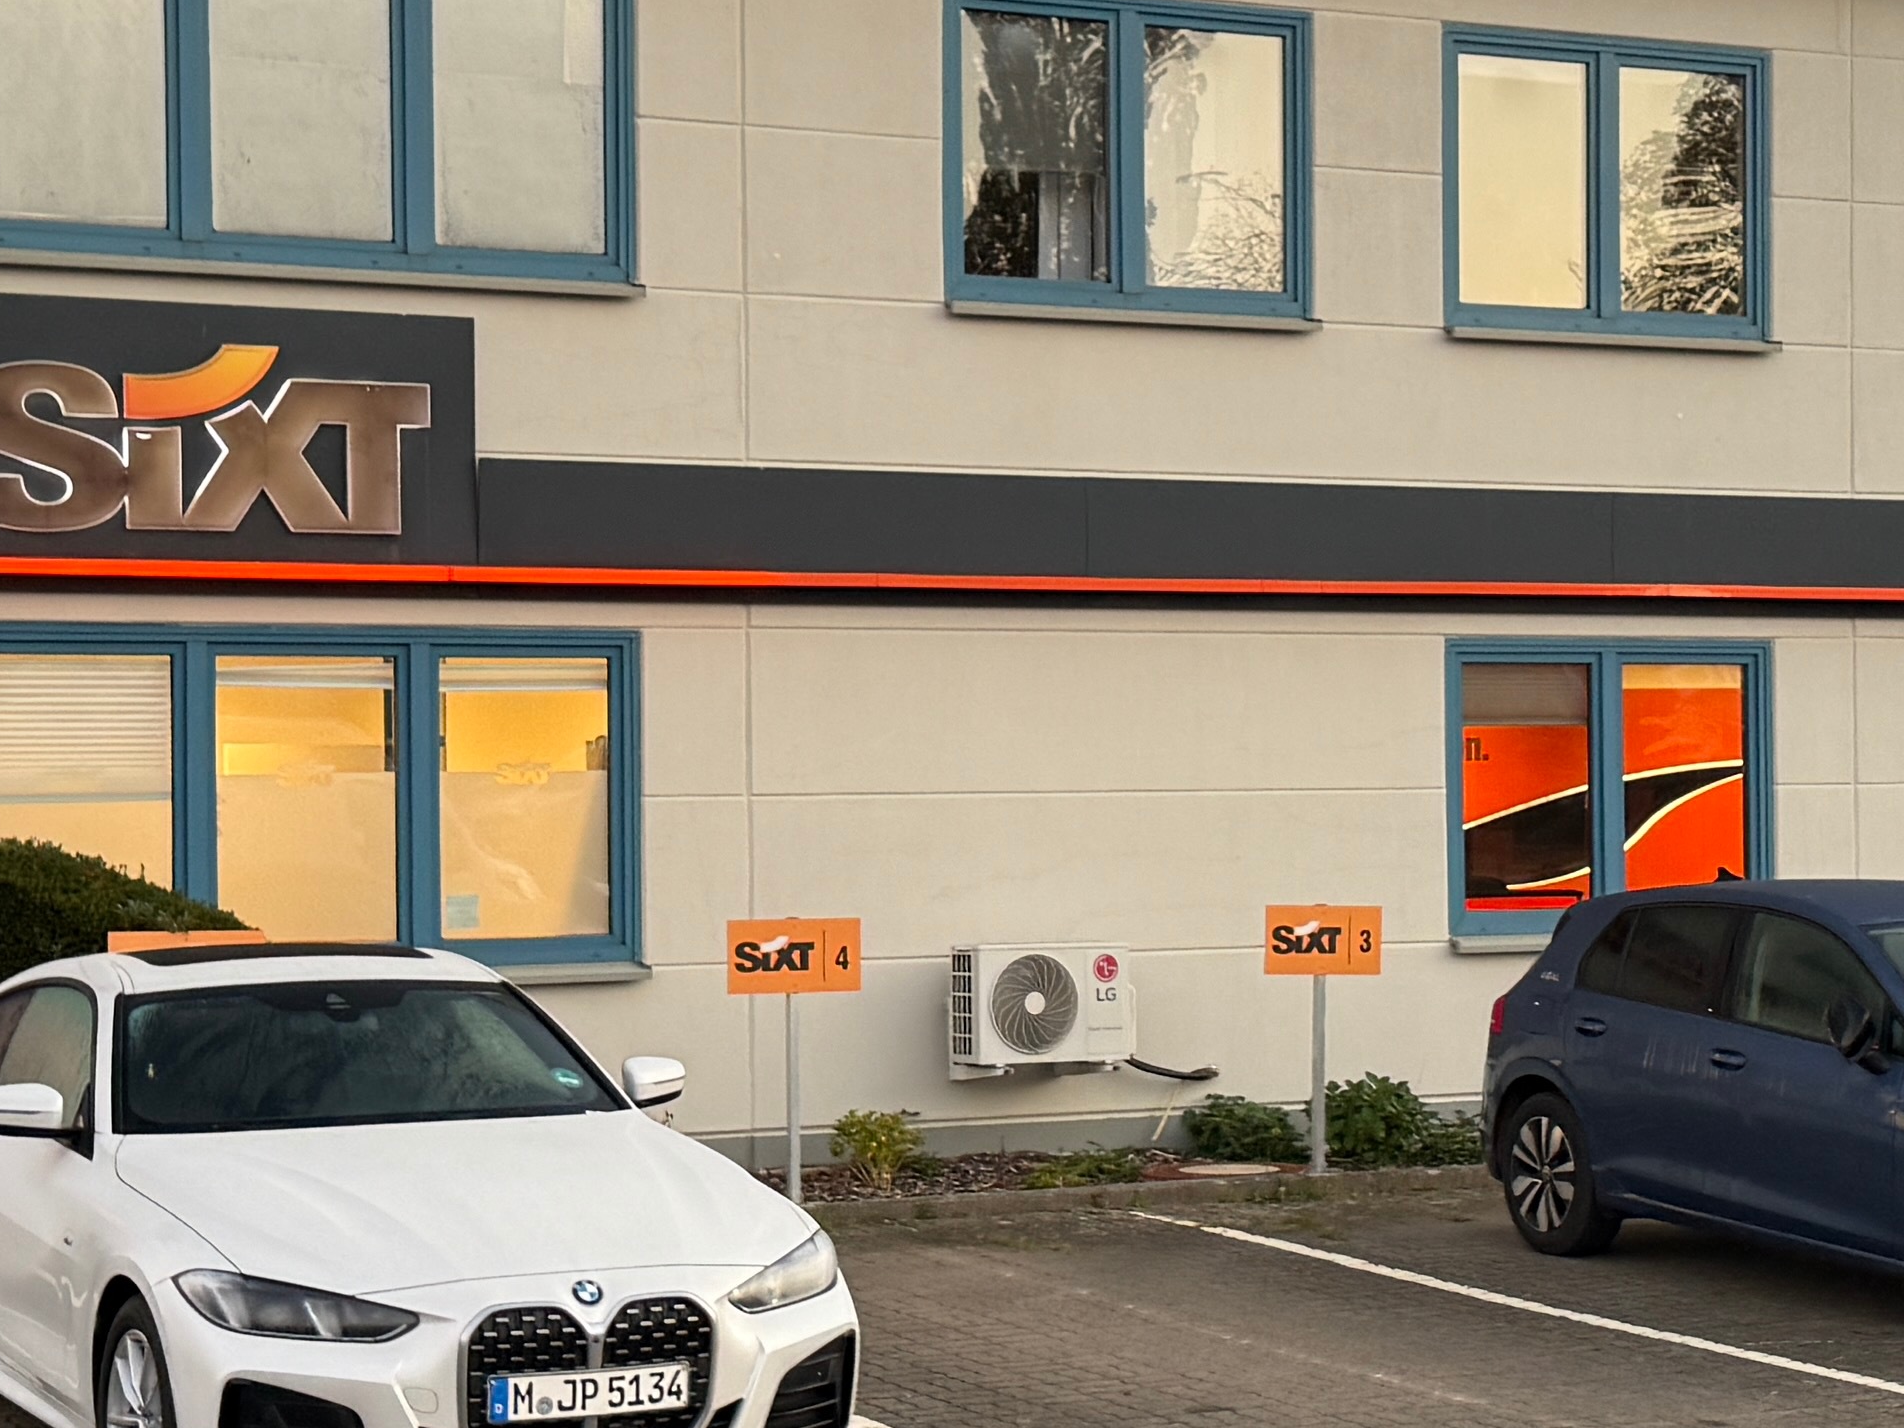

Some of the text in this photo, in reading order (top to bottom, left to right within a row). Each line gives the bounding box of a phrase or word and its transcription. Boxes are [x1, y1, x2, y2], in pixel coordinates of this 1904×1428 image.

[1359, 929, 1372, 953] 3
[835, 945, 849, 970] 4
[1096, 987, 1117, 1002] LG
[513, 1381, 534, 1415] M
[557, 1378, 599, 1412] JP
[607, 1369, 683, 1409] 5134
